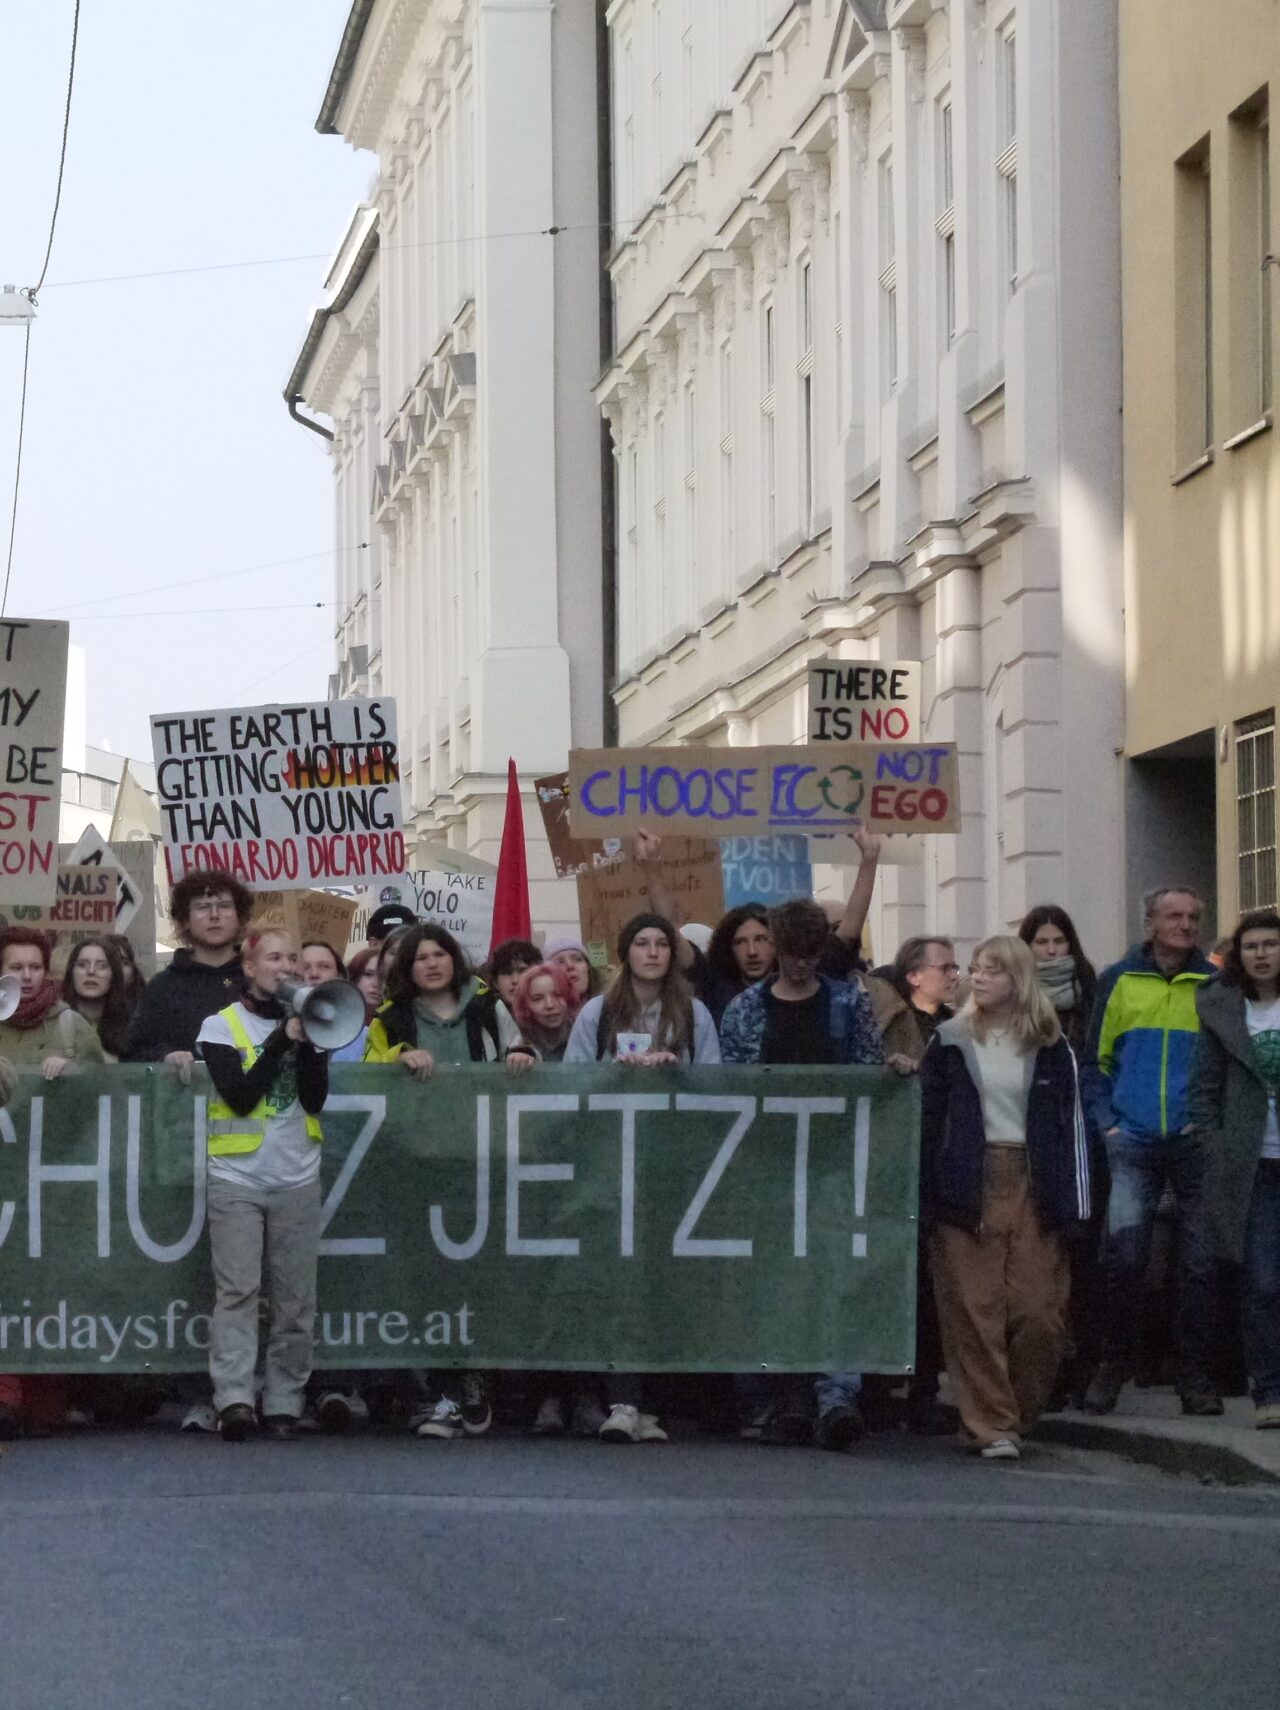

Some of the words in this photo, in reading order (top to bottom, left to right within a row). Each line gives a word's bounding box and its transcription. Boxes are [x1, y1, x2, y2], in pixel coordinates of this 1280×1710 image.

[813, 668, 909, 700] THERE
[154, 717, 218, 755] THE
[231, 707, 334, 750] EARTH
[353, 702, 387, 741] IS
[811, 706, 852, 741] IS
[859, 707, 910, 740] NO
[5, 743, 58, 785] BE
[157, 749, 282, 801] GETTING
[292, 740, 399, 790] HOTTER
[875, 747, 948, 783] NOT
[580, 764, 759, 819] CHOOSE
[870, 784, 948, 821] EGO
[161, 798, 262, 843] THAN
[282, 788, 395, 835] YOUNG
[307, 831, 406, 879] DICAPRIO
[414, 886, 459, 914] YOLO
[444, 872, 486, 890] TAKE
[429, 1093, 871, 1261] JETZT!
